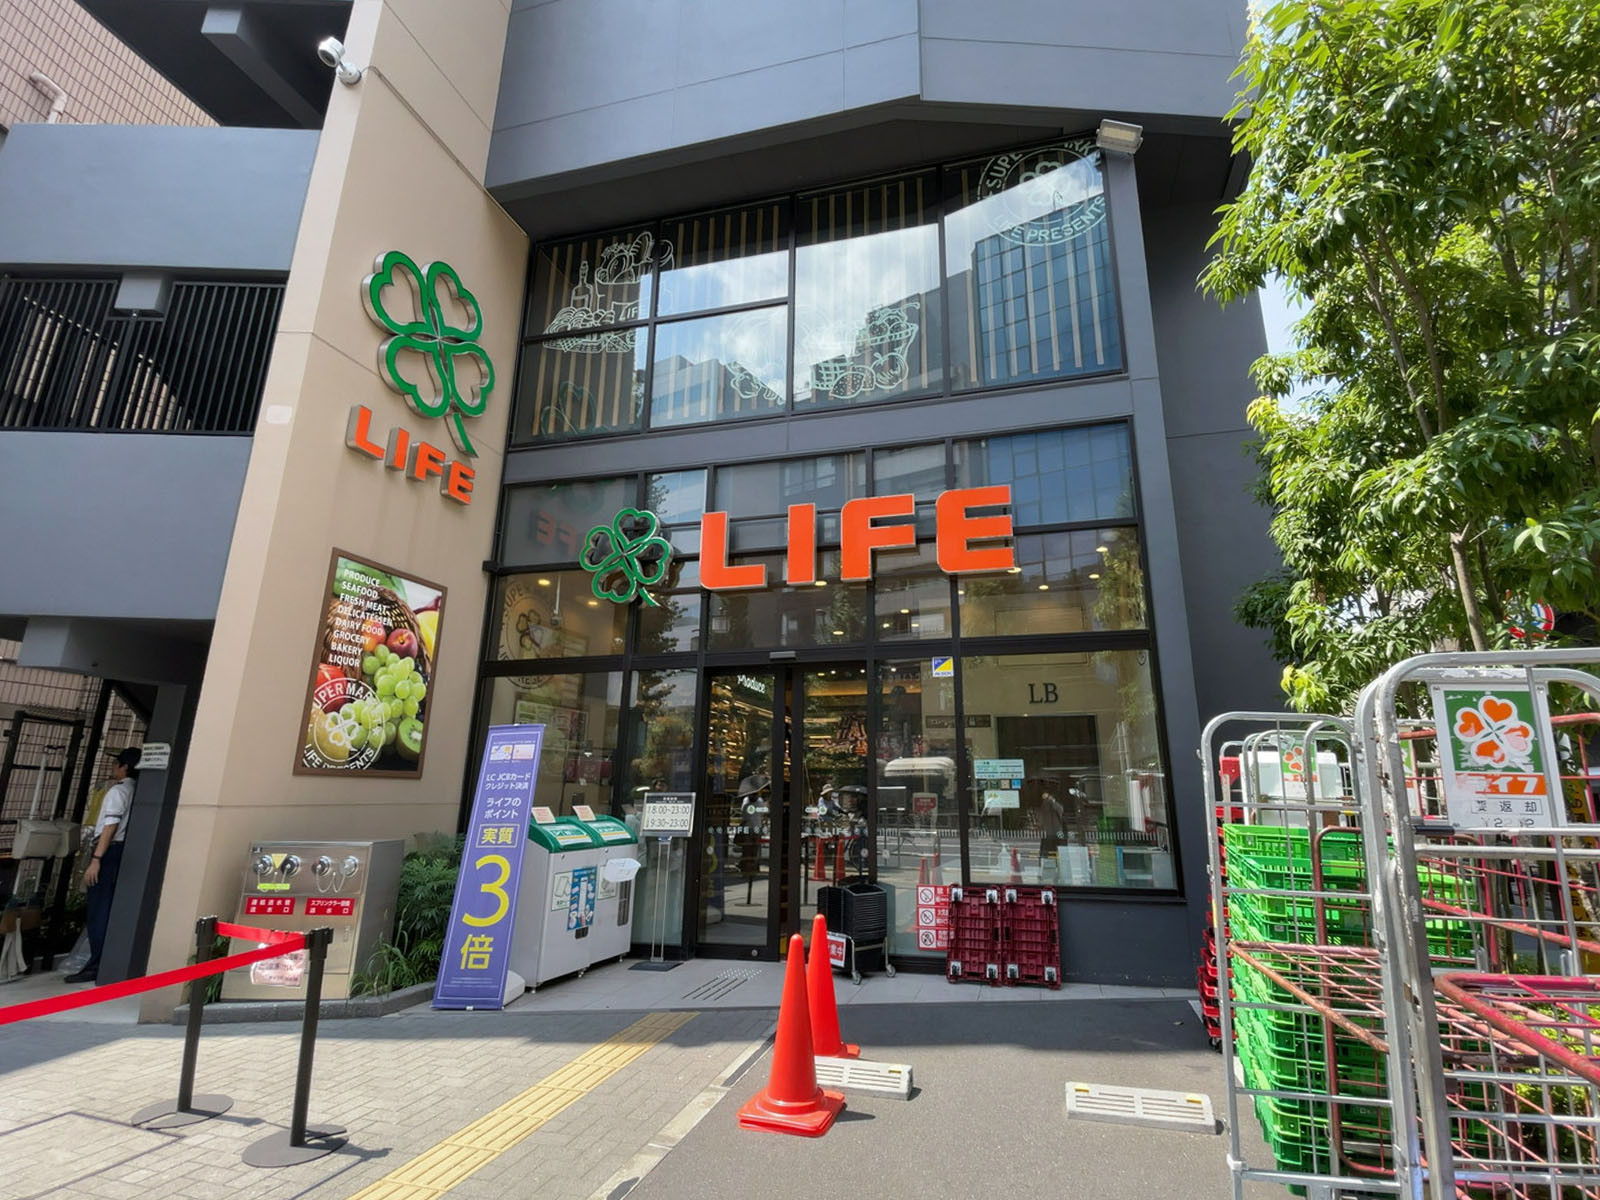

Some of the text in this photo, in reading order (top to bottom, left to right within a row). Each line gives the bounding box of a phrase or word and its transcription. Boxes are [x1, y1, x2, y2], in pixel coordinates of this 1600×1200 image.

[986, 151, 1023, 188] SUPE
[346, 405, 476, 505] LIFE
[700, 485, 1015, 590] LIFE
[343, 568, 381, 587] PRODUCE
[341, 581, 378, 599] SEAFOOD
[340, 593, 387, 614] FRESH MEAT
[337, 605, 393, 627] DELICATESSEN
[334, 617, 383, 636] DAIRY FOOD
[333, 630, 371, 645] GROCERY
[331, 642, 363, 656] BAKERY
[328, 654, 360, 667] LIQUOR
[314, 683, 343, 709] UPER
[1028, 682, 1059, 704] LB
[487, 797, 522, 807] ライフの
[484, 809, 518, 819] ポイント
[481, 827, 514, 844] 実質
[461, 854, 511, 928] 3
[460, 934, 494, 970] 倍
